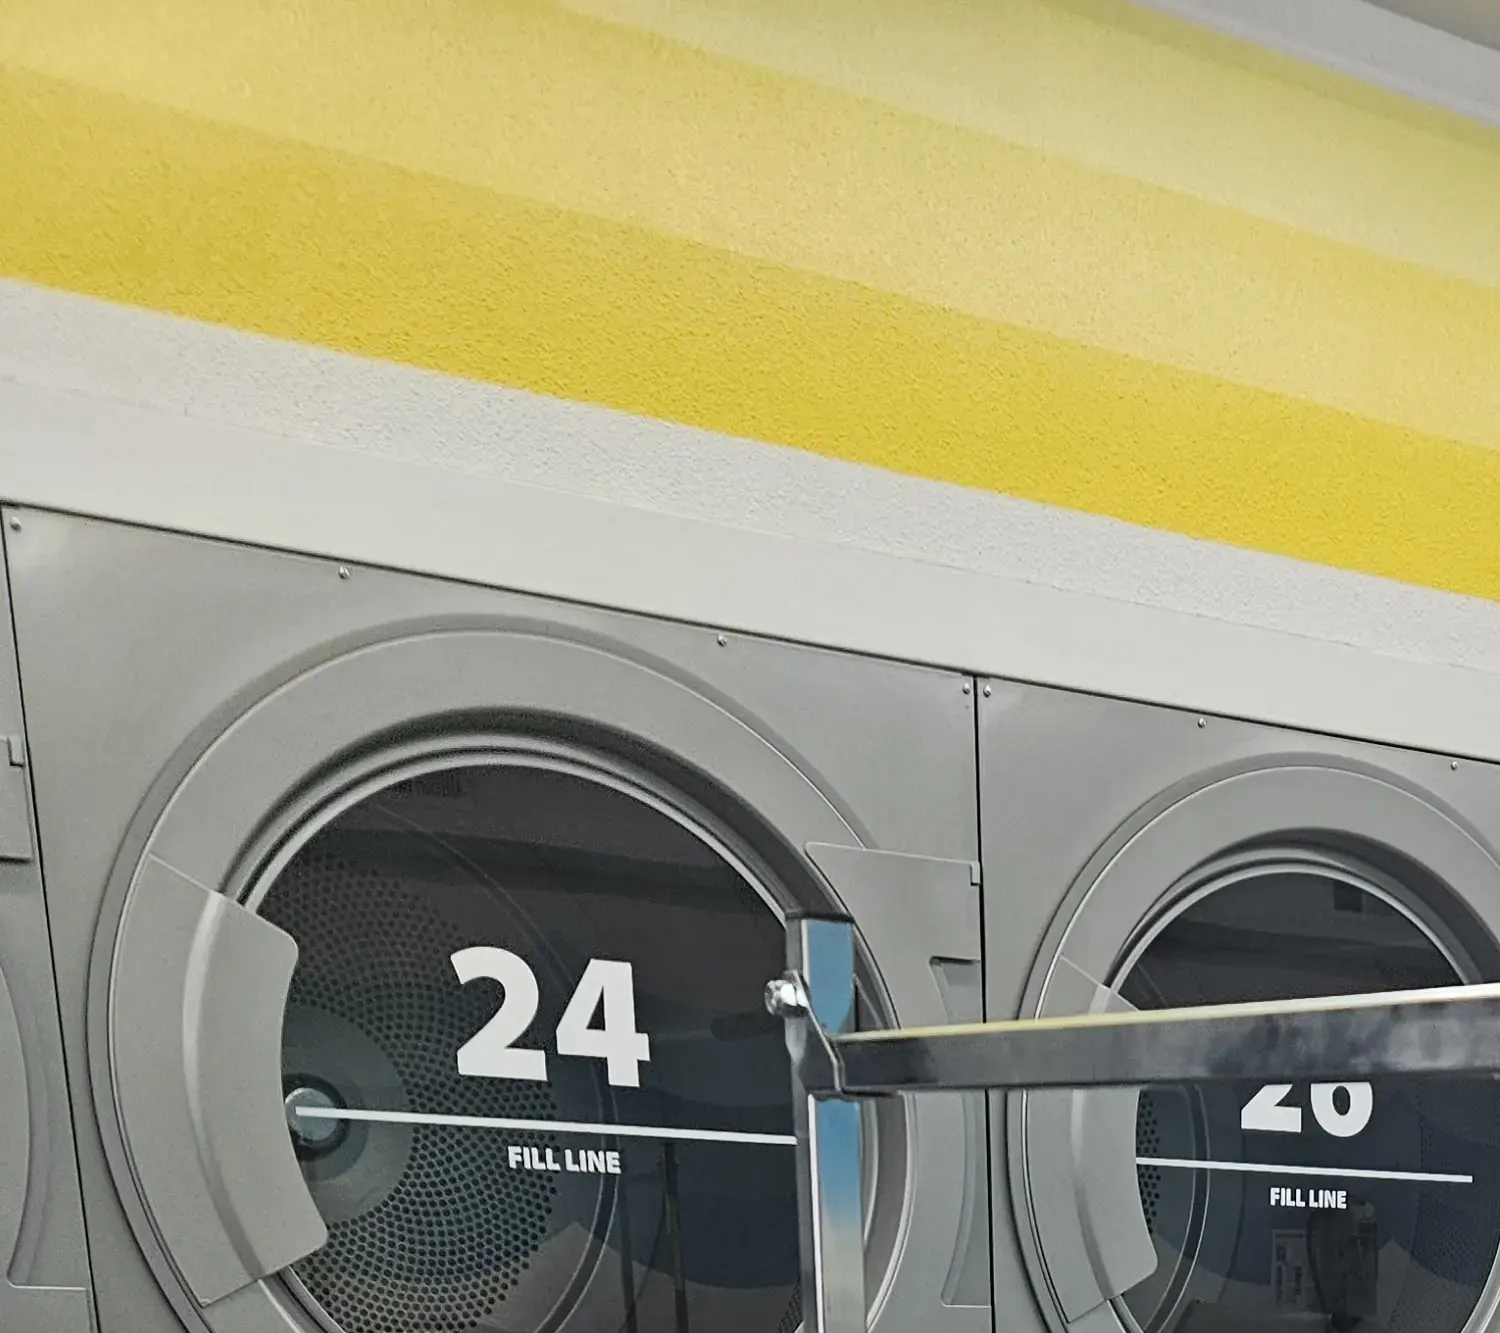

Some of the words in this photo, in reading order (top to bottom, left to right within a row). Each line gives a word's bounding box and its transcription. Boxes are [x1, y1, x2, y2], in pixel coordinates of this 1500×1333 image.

[450, 946, 650, 1087] 24
[508, 1145, 560, 1171] FILL
[565, 1149, 621, 1174] LINE
[1270, 1187, 1305, 1207] FILL
[1309, 1189, 1347, 1209] LINE
